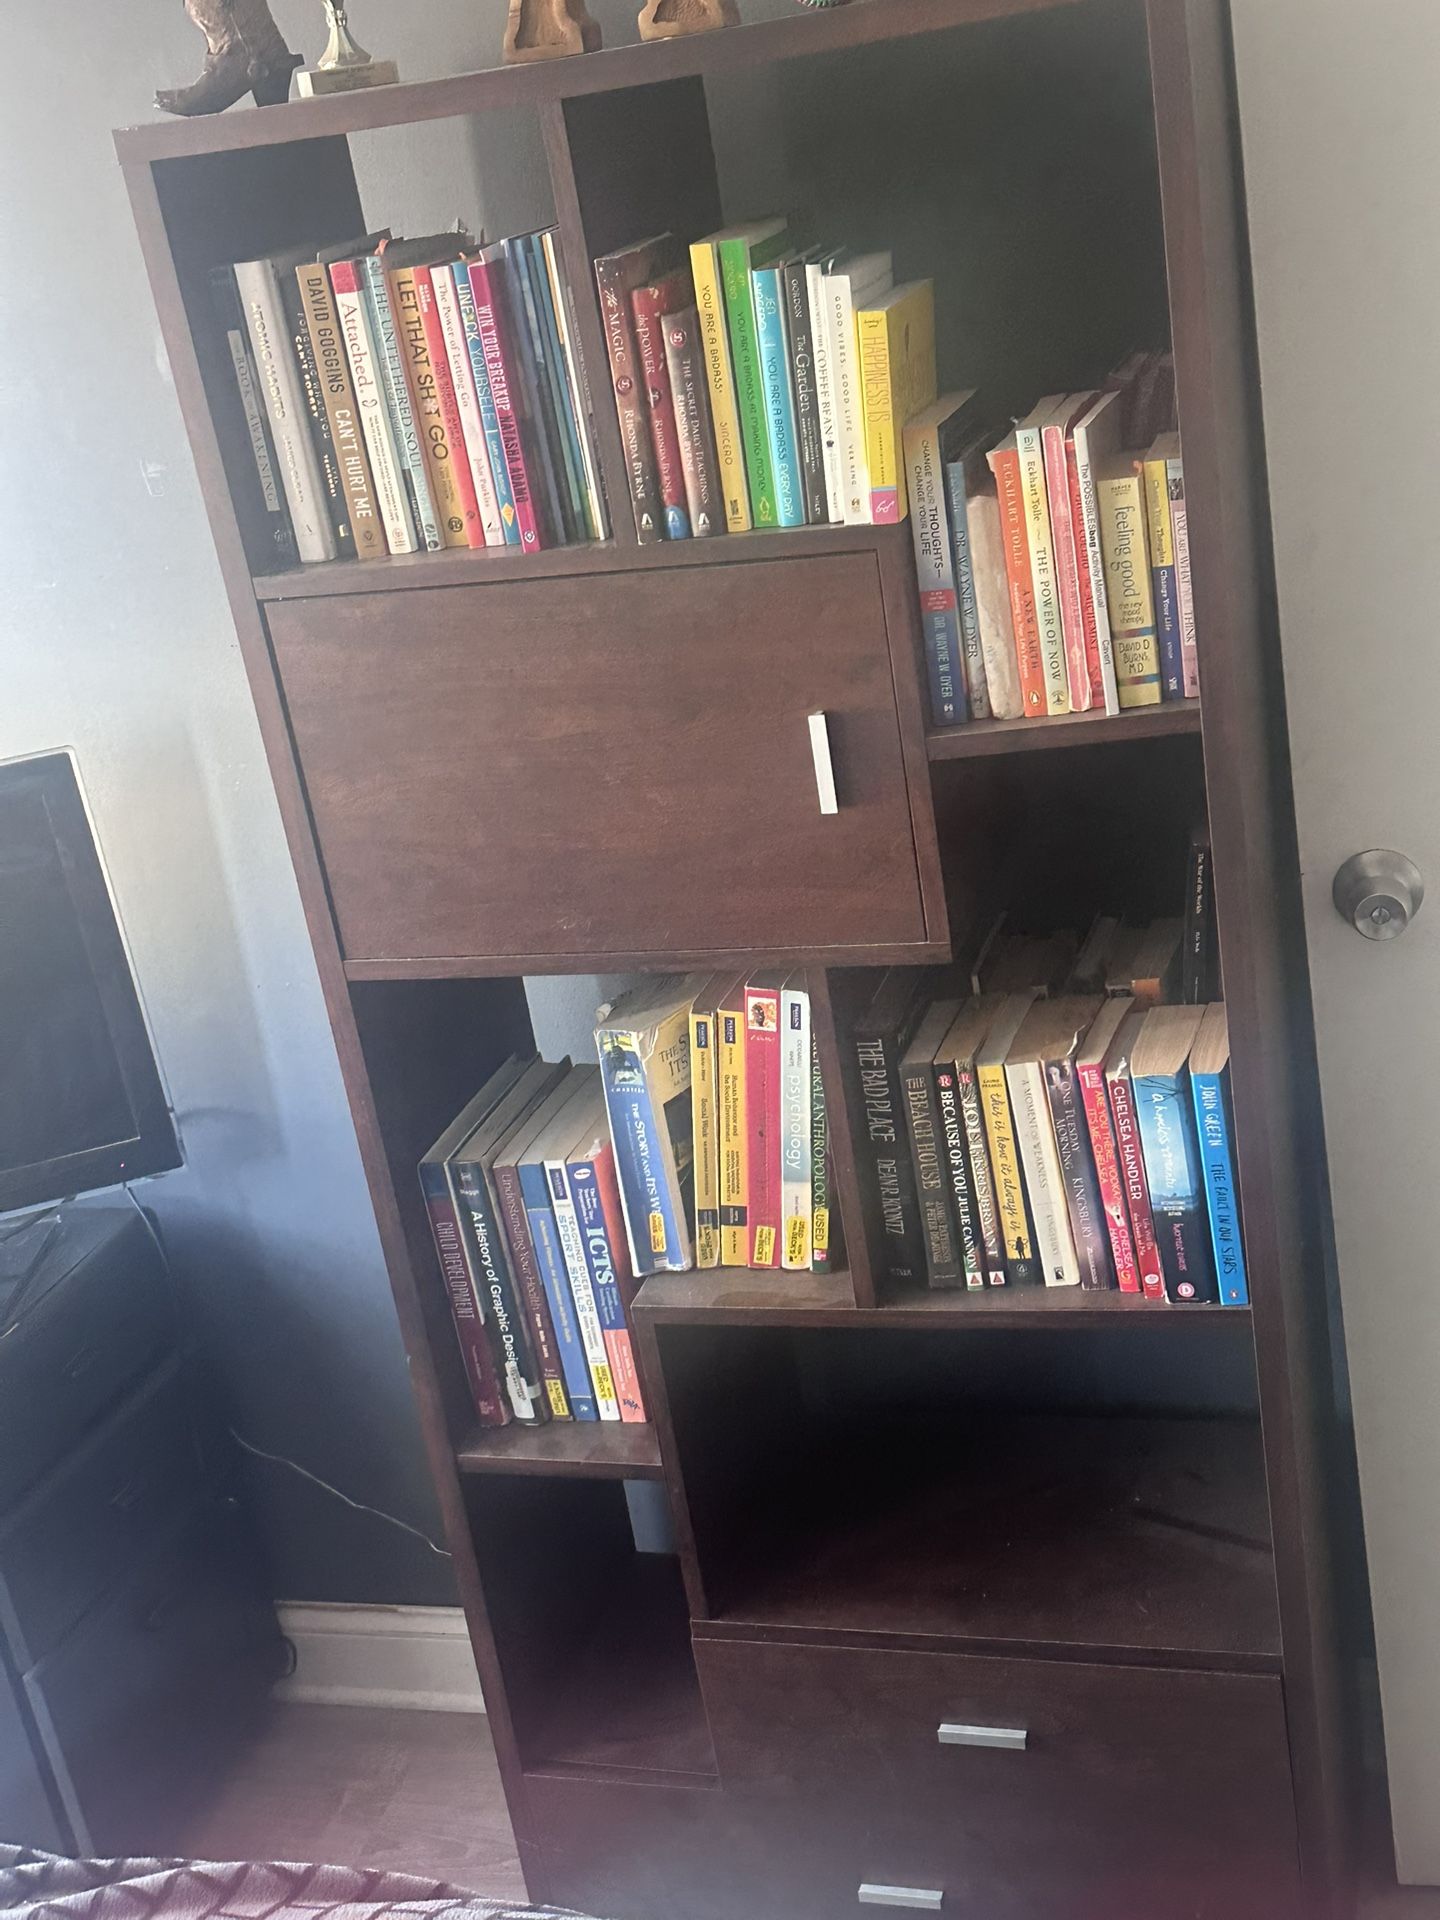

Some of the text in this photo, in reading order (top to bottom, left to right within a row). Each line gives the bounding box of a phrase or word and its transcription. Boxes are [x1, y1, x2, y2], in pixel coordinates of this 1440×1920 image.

[373, 281, 391, 314] THE
[396, 279, 419, 314] LET
[700, 284, 713, 310] YOU
[765, 296, 776, 315] JEN
[790, 278, 803, 318] GORDON
[340, 300, 376, 394] Attached.
[404, 316, 430, 370] THAT
[438, 283, 471, 408] The Power of Letting Go
[608, 312, 626, 363] MAGIC
[705, 313, 716, 334] ARE
[708, 337, 717, 345] A
[796, 335, 807, 351] The
[249, 300, 286, 420] ATOMIC HABITS
[379, 318, 415, 429] UNTETHERED
[794, 353, 815, 413] Garden
[860, 336, 892, 407] HAPPINESS
[306, 276, 373, 519] DAVID GOGGINS CAN'T HURT ME
[470, 347, 495, 422] YOURSELF
[477, 304, 530, 504] WIN YOUR BREAKUP NATASHA ADAMO
[816, 349, 835, 436] COFFEE BEAN
[403, 431, 423, 471] SOUL
[427, 423, 449, 461] GO
[623, 409, 641, 458] RHONDA
[718, 421, 734, 467] SINCERO
[766, 356, 795, 518] YOU ARE A BADASS EVERY DAY
[631, 461, 647, 500] BYRNE
[920, 440, 933, 477] CHANGE
[1080, 463, 1091, 479] The
[913, 465, 932, 556] CHANGE YOUR LIFE
[926, 479, 936, 505] YOUR
[1002, 462, 1019, 523] ECKHART
[1010, 527, 1024, 568] TOLLE
[1027, 460, 1062, 682] Eckhart Tolle THE POWER OF NOW
[1089, 549, 1103, 579] Activity
[1110, 505, 1141, 599] feeling good
[1023, 599, 1034, 625] NEW
[1094, 579, 1106, 609] Manual
[1118, 640, 1142, 651] DAVID
[659, 1047, 678, 1062] THE
[857, 1038, 885, 1069] THE
[861, 1067, 890, 1100] BAD
[1094, 1090, 1107, 1109] ARE
[785, 1075, 801, 1170] psychology
[865, 1097, 896, 1145] PLACE
[907, 1089, 941, 1191] BEACH HOUSE
[1060, 1081, 1082, 1153] ONE TUESDAY
[1098, 1109, 1110, 1130] YOU
[634, 1119, 650, 1160] STORY
[645, 1177, 657, 1196] ITS
[988, 1093, 1024, 1232] this is how it always is
[1055, 1117, 1074, 1171] MORNING
[1087, 1108, 1098, 1125] IT'S
[1093, 1142, 1109, 1185] CHELSEA
[1112, 1085, 1143, 1201] CHELSEA HANDLER
[876, 1156, 899, 1189] DEAN
[940, 1090, 979, 1270] BECAUSE OF YOU JULIE CANNON
[1107, 1164, 1121, 1201] VODKA?
[1199, 1083, 1238, 1276] JOHN GREEN THE FAULT IN OUR STARS
[471, 1209, 484, 1222] A
[815, 1214, 824, 1241] USED
[882, 1196, 905, 1237] KOONTZ
[1071, 1176, 1093, 1240] KINGSBURY
[474, 1222, 496, 1268] History
[499, 1172, 543, 1312] Understanding Your Health
[557, 1213, 587, 1315] SPORT SKILLS
[568, 1214, 584, 1263] TEACHING
[584, 1294, 594, 1313] FOR
[585, 1225, 614, 1286] ICTS
[1109, 1227, 1125, 1270] HANDLER
[1118, 1228, 1134, 1269] CHELSEA
[436, 1220, 475, 1322] CHILD DEVELOPMENT
[486, 1268, 500, 1282] of
[488, 1283, 512, 1333] Graphic
